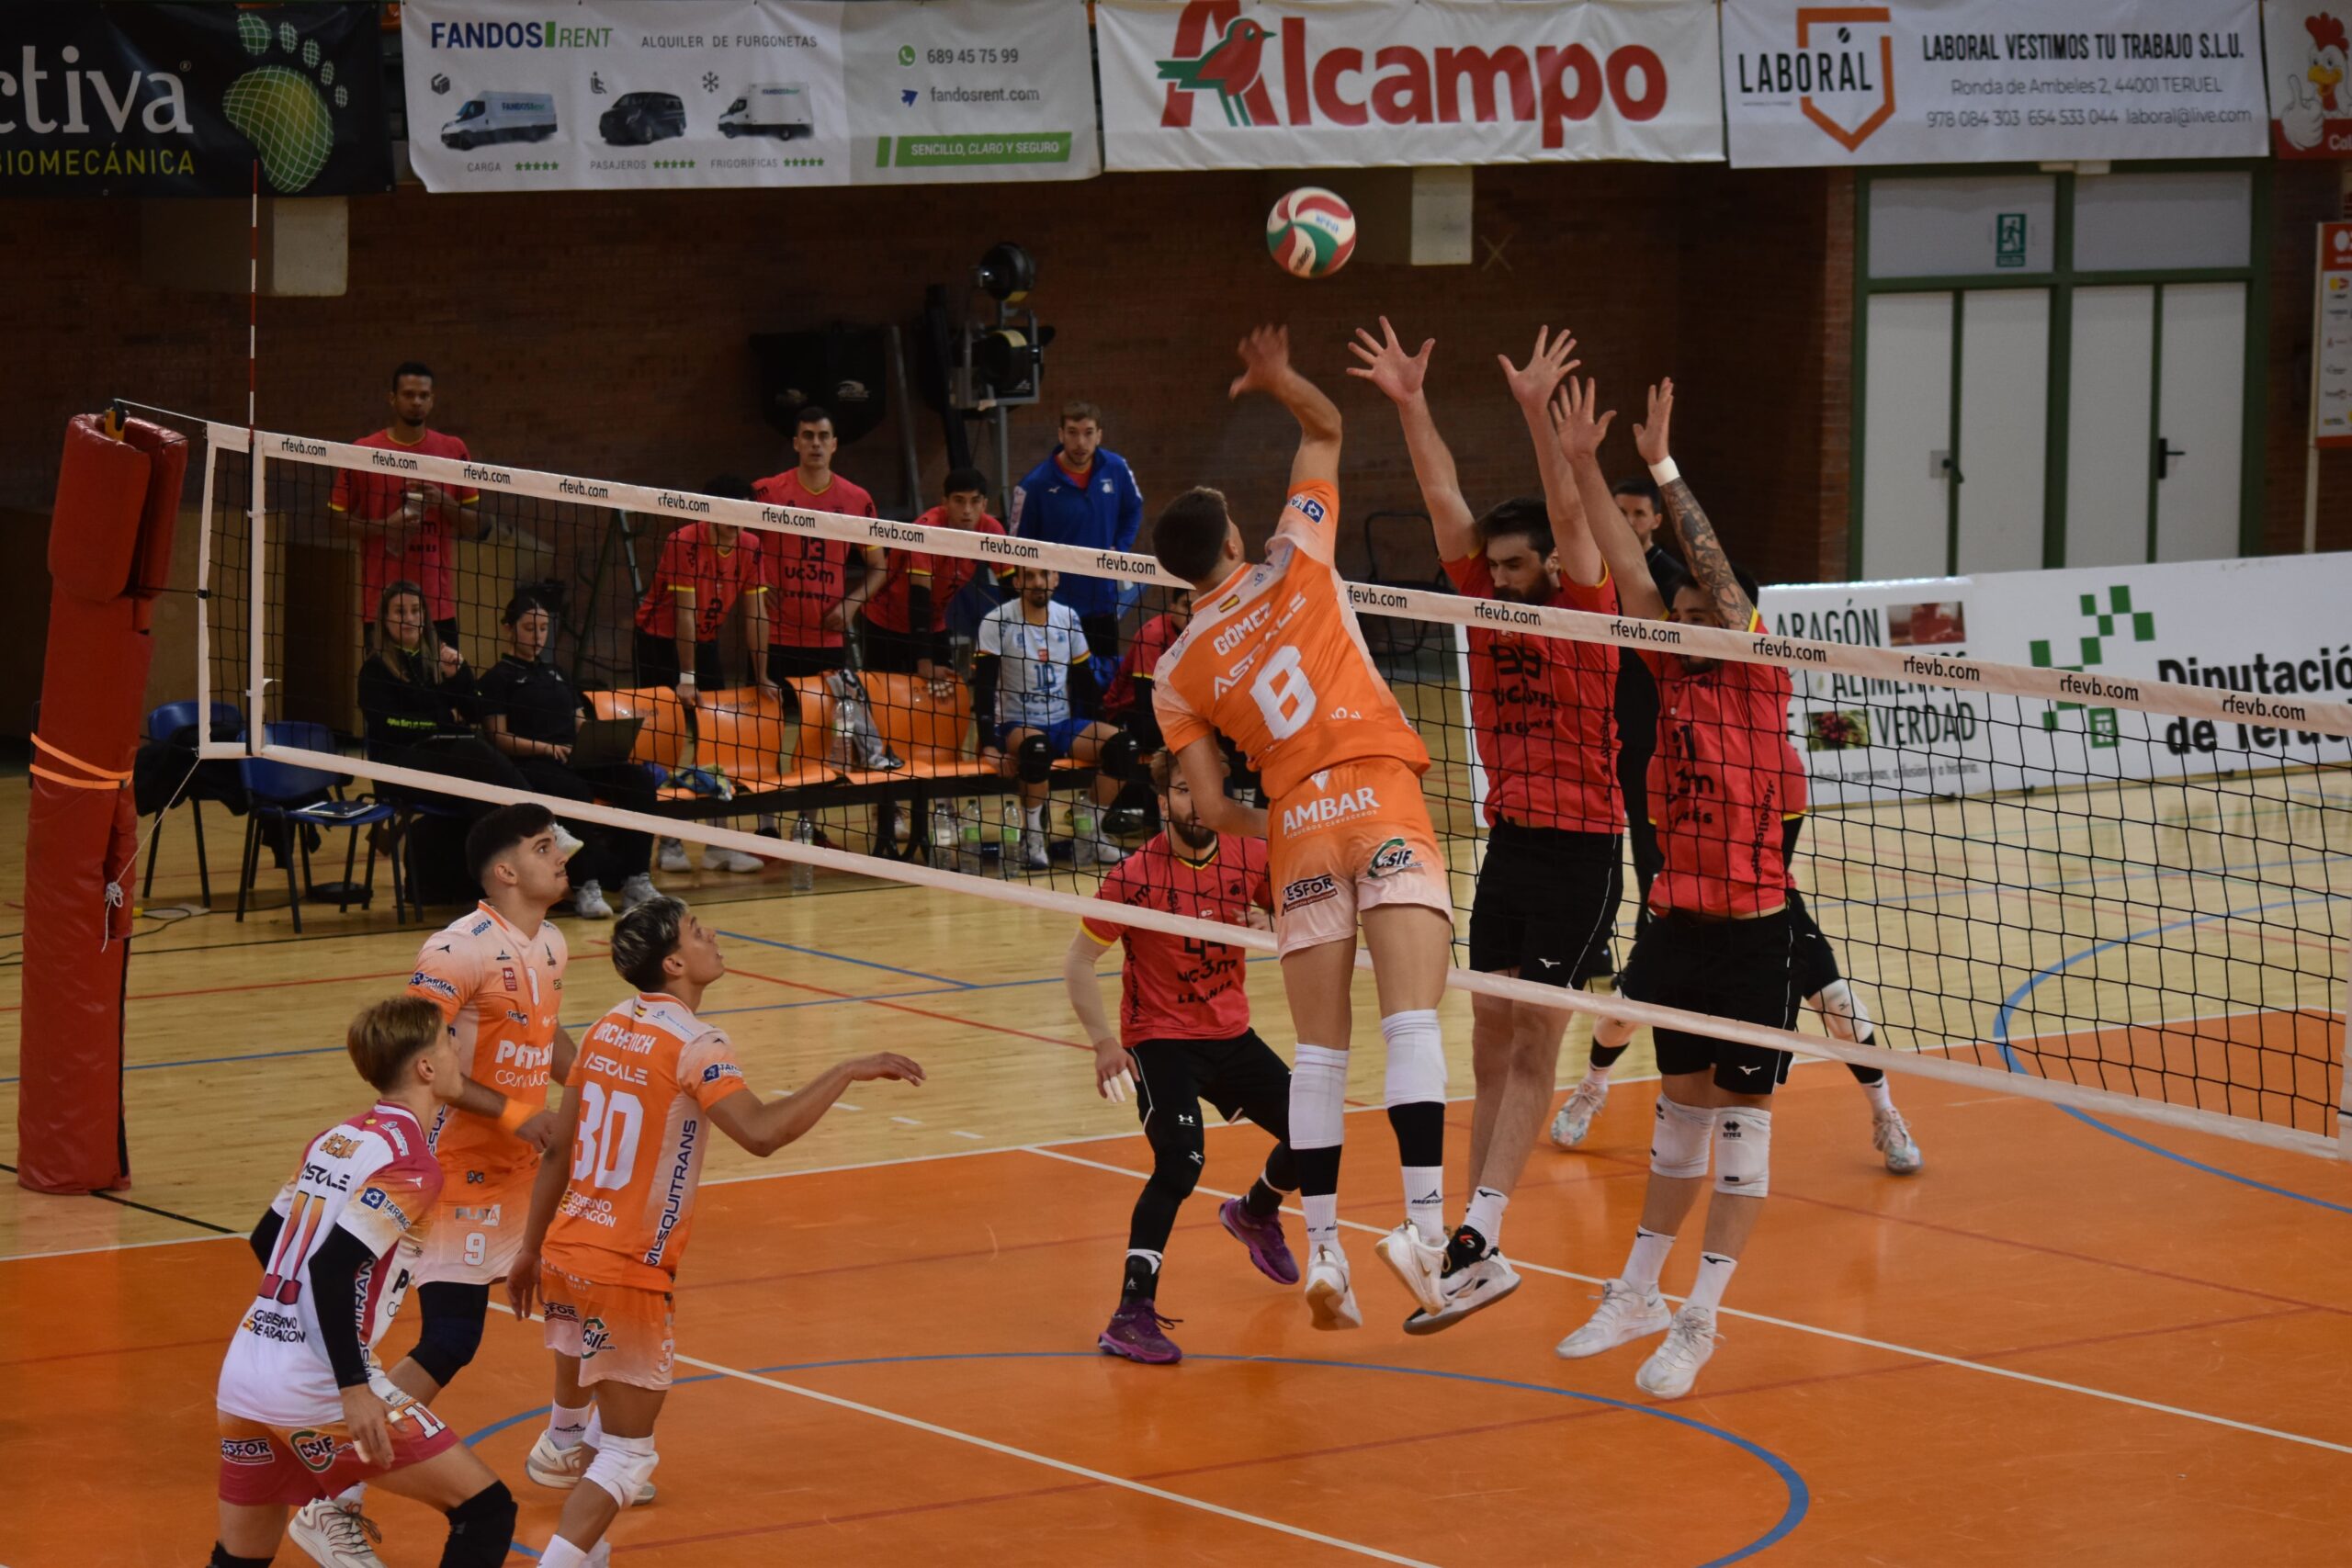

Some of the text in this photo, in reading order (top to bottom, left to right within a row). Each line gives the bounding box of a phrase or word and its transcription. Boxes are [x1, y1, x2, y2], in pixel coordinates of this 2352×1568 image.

[431, 22, 614, 49] FANDOS RENT
[641, 35, 817, 50] ALQUILER DE FURGONETAS
[1922, 32, 2245, 61] LABORAL VESTIMOS TU TRABAJO S.L.U.
[927, 48, 1019, 64] 689 45 75 99
[1159, 0, 1668, 149] Alcampo
[1951, 77, 2003, 95] Ronda
[2006, 78, 2026, 95] de
[2030, 77, 2096, 95] Ambeles
[2115, 77, 2159, 93] 44001
[2161, 76, 2222, 93] TERUEL
[930, 86, 1040, 103] fandosrent.com
[1928, 107, 2252, 128] 978 084 303 654 533 044 laboral@live.com
[910, 140, 1059, 156] SENCILLO, CLARO Y SEGURO
[467, 163, 502, 173] CARGA
[590, 159, 647, 171] PASAJEROS
[710, 157, 778, 169] FRIGORÍFICAS
[281, 437, 327, 457] rfevb.com
[372, 450, 418, 471] rfevb.com
[463, 464, 511, 485] rfevb.com
[559, 479, 608, 499] rfevb.com
[658, 492, 710, 513] rfevb.com
[762, 506, 816, 528] rfevb.com
[868, 521, 924, 544] rfevb.com
[979, 536, 1039, 559] rfevb.com
[785, 564, 835, 584] uc3m
[1096, 553, 1156, 576] rfevb.com
[1474, 601, 1541, 626] rfevb.com
[1776, 599, 1882, 648] ARAGÓN
[1214, 602, 1273, 656] GÓMEZ
[1610, 620, 1680, 644] rfevb.com
[1753, 638, 1826, 663] rfevb.com
[1903, 656, 1980, 682] rfevb.com
[2060, 674, 2139, 702] rfevb.com
[2222, 694, 2307, 722] rfevb.com
[1875, 701, 1977, 747] VERDAD
[2166, 716, 2217, 755] de
[1283, 786, 1382, 836] AMBAR
[573, 1078, 644, 1190] 30
[384, 1199, 412, 1230] TARMAC
[257, 1189, 326, 1305] 11
[463, 1232, 486, 1266] 9
[254, 1308, 298, 1330] GOBIERNO
[582, 1328, 610, 1351] CSIF
[300, 1435, 334, 1459] CSIF
